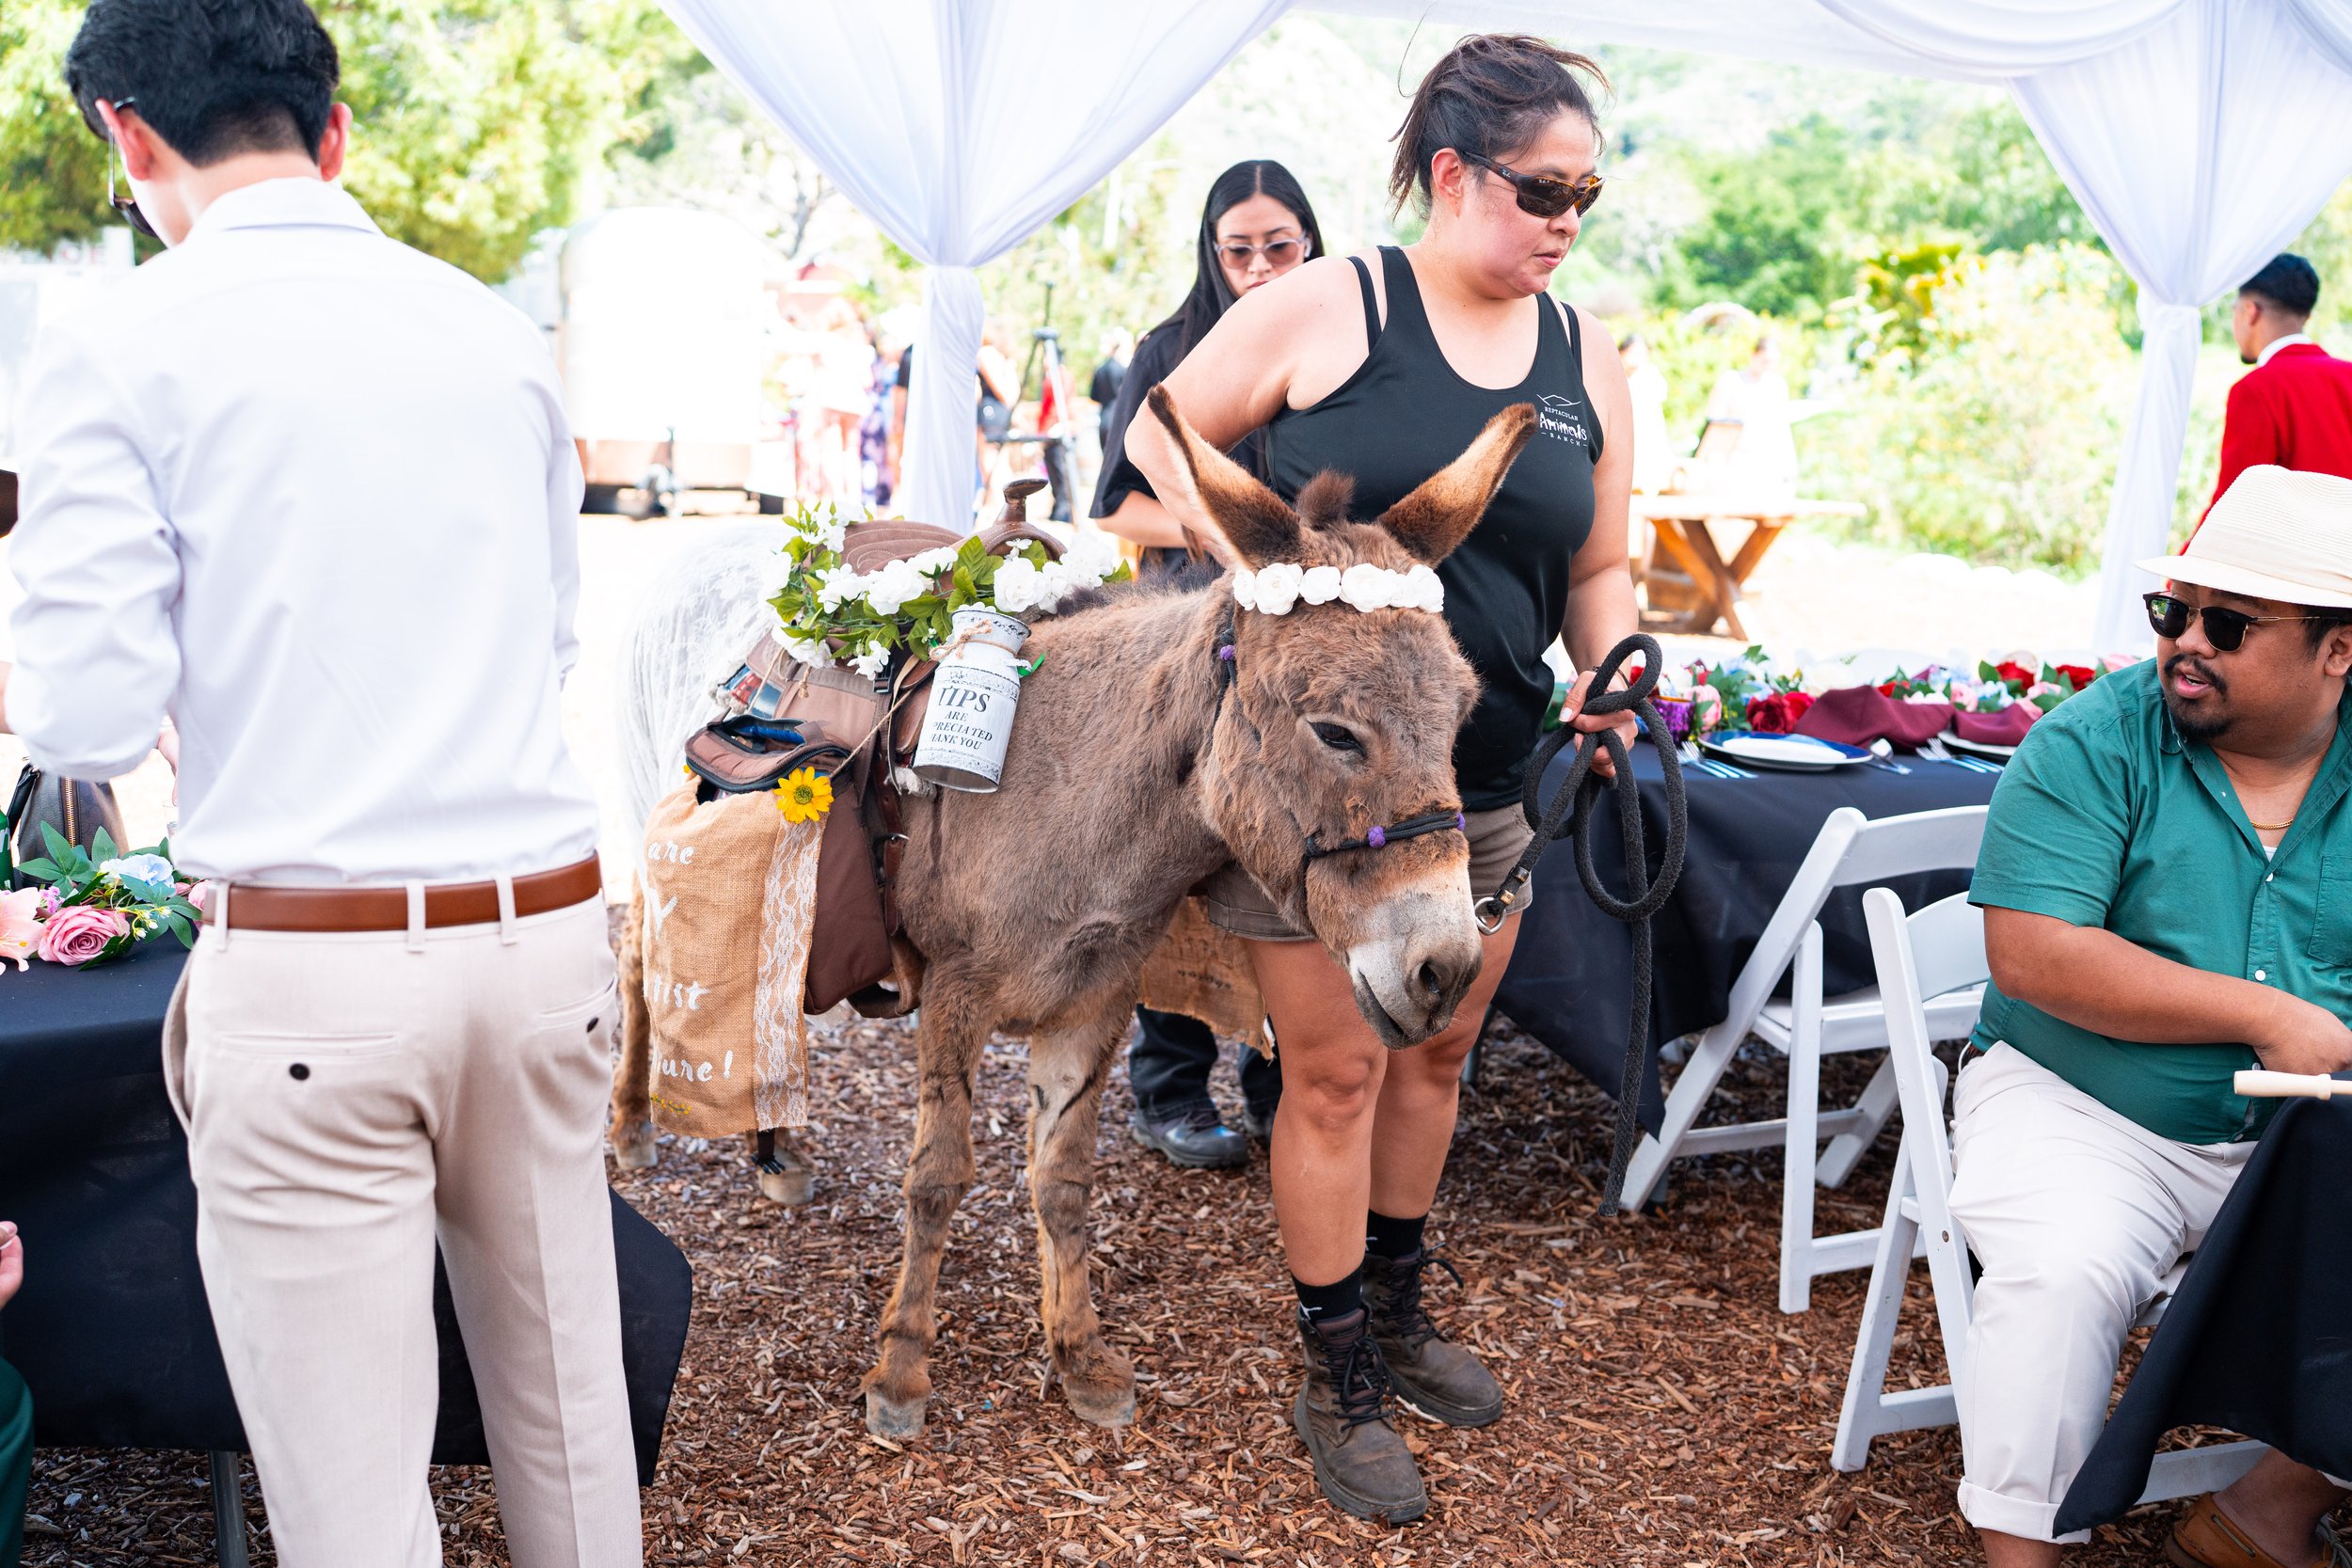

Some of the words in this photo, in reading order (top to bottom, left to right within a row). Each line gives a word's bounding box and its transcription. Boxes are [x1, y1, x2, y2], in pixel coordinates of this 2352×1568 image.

[1544, 406, 1579, 421] REPTACULAR
[1539, 411, 1588, 441] Animals
[1549, 432, 1581, 447] RANCH
[938, 685, 991, 713] TIPS
[945, 710, 969, 722] ARE
[960, 736, 983, 751] YOU
